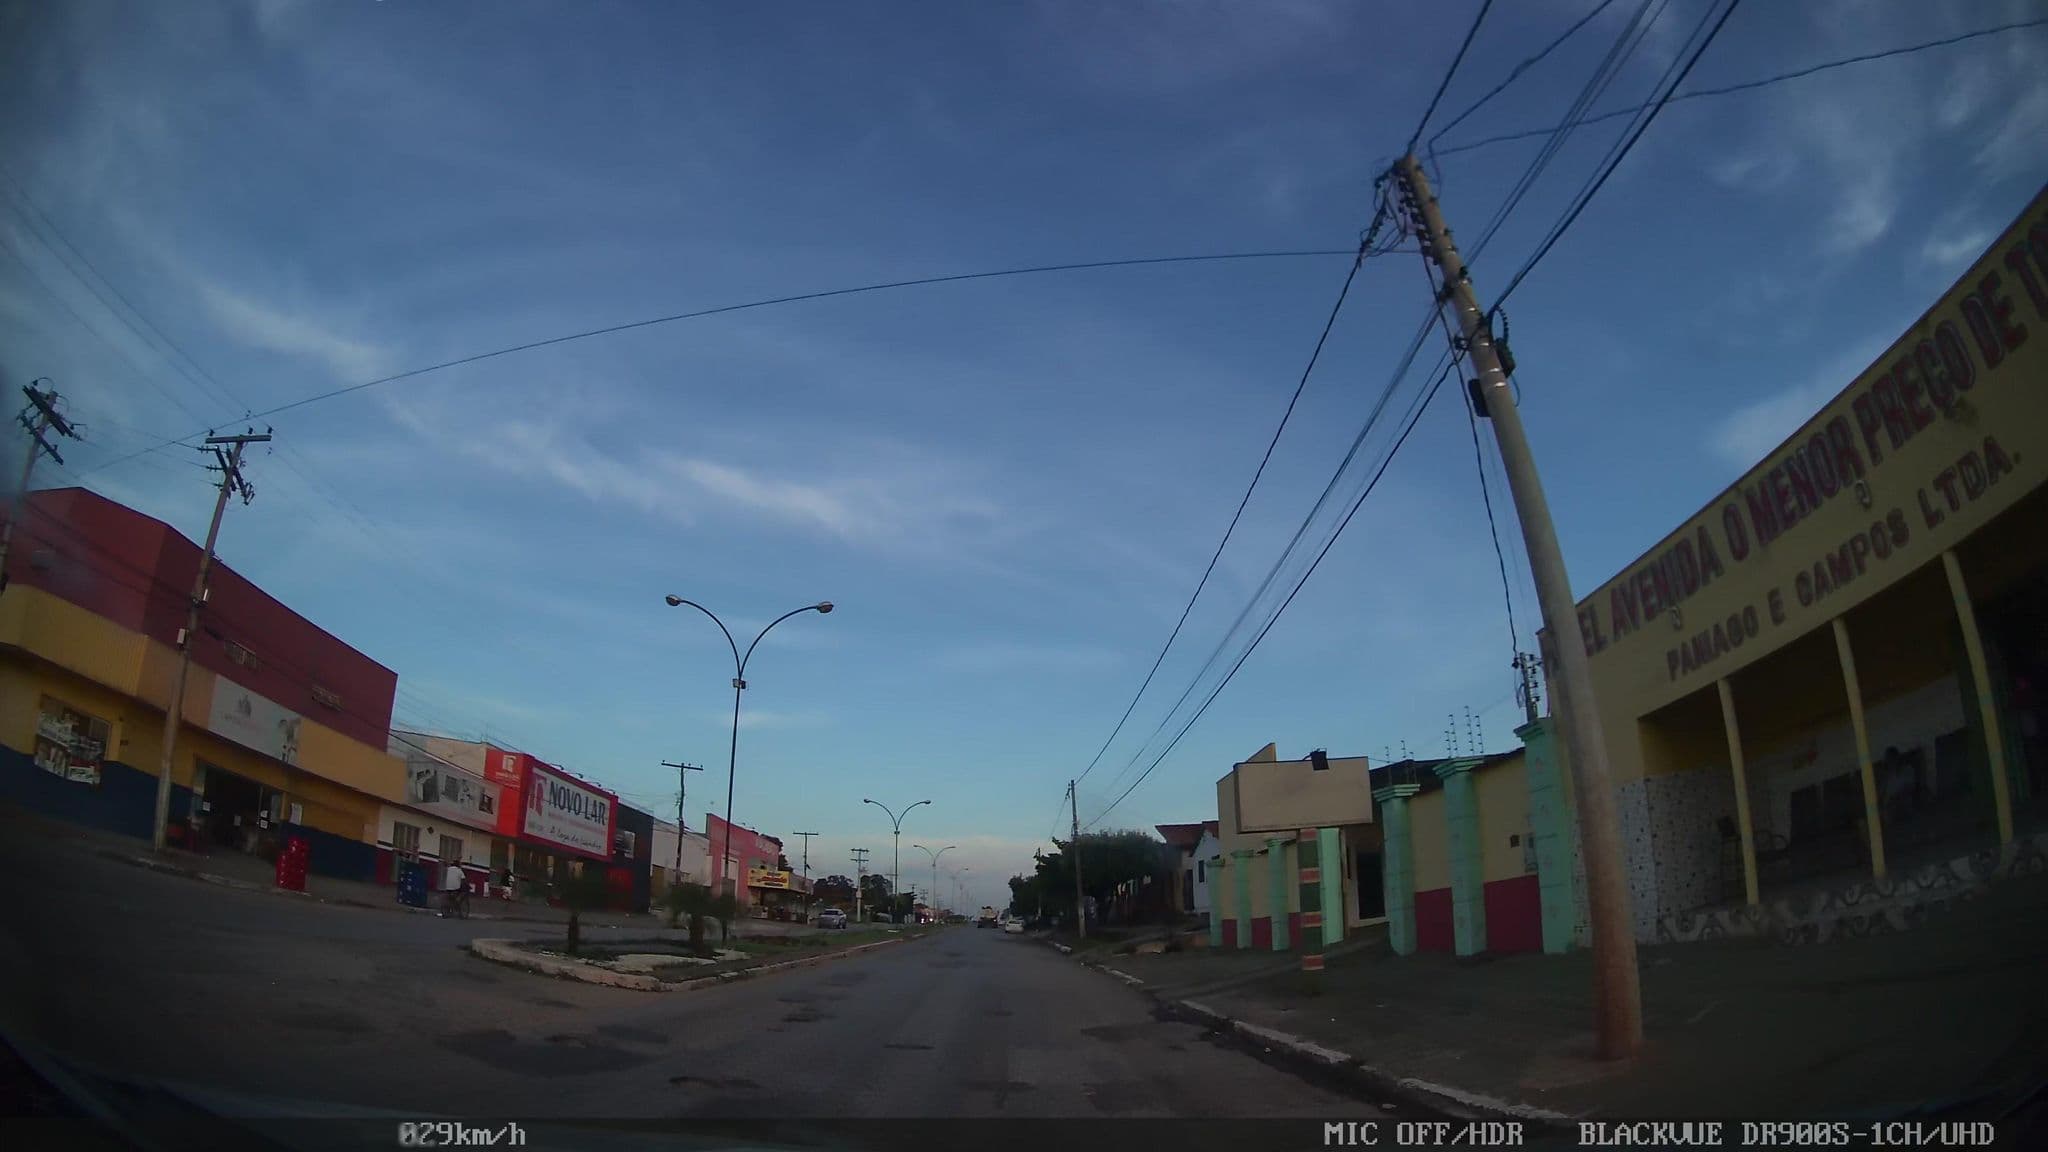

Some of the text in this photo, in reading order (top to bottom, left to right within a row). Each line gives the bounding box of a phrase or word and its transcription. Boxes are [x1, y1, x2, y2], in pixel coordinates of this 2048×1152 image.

[1576, 602, 1608, 657] EL
[1610, 524, 1725, 642] AVENIDA
[1722, 503, 1750, 562] O
[1744, 415, 1866, 547] MENOR
[1852, 318, 1976, 467] PREÇO
[1960, 268, 2029, 370] DE
[1766, 587, 1786, 626] E
[1795, 507, 1910, 607] CAMPOS
[1917, 435, 2021, 530] LTDA.
[549, 781, 606, 826] NOVO LAR
